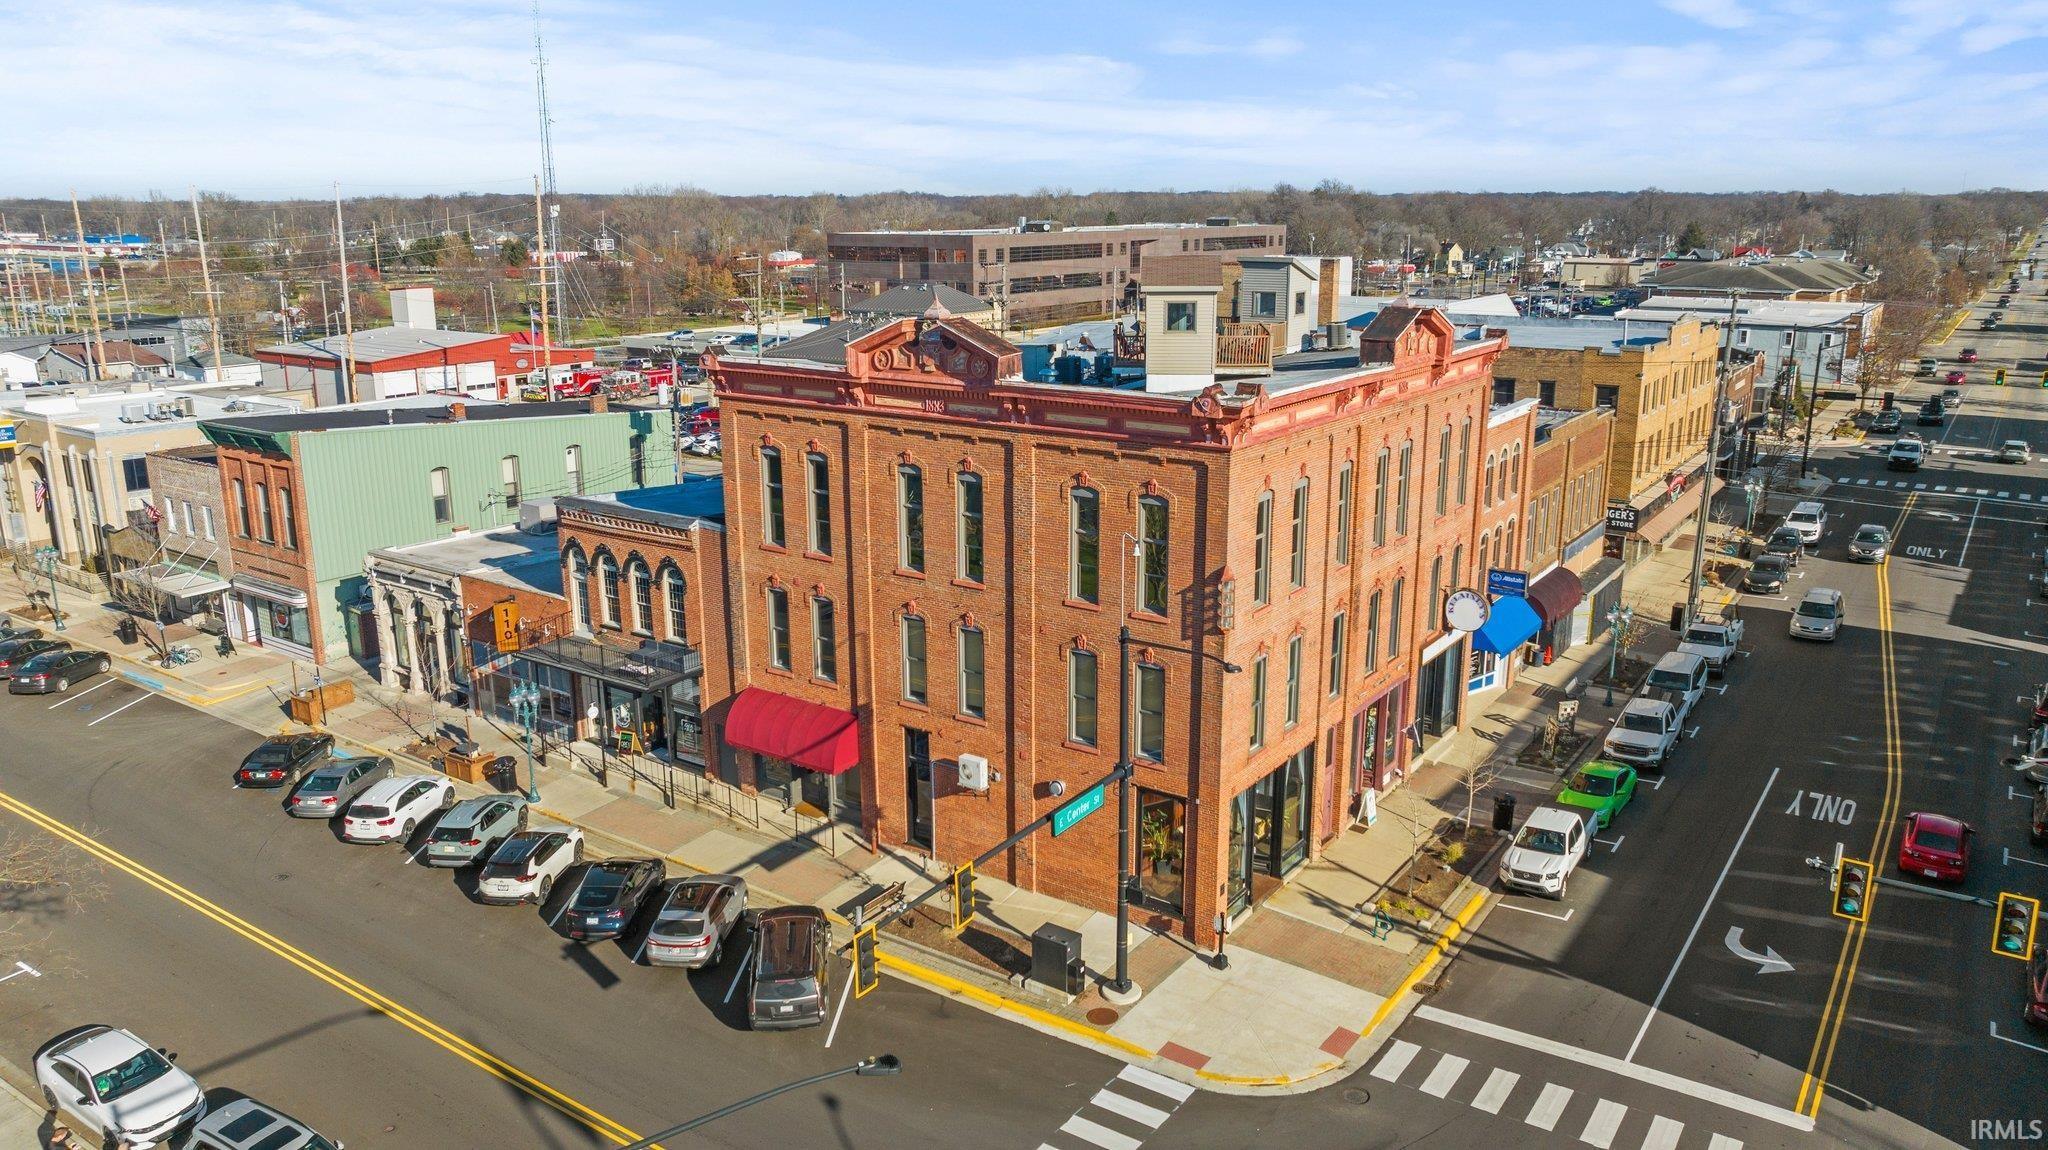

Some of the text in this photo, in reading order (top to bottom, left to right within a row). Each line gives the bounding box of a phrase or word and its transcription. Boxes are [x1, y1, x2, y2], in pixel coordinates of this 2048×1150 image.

[1611, 520, 1634, 529] STORE
[1906, 545, 1948, 559] ONLY
[1502, 575, 1524, 584] Allstate
[503, 608, 513, 640] 110
[1059, 816, 1065, 828] E
[1066, 800, 1091, 823] Center
[1785, 789, 1857, 826] ONLY
